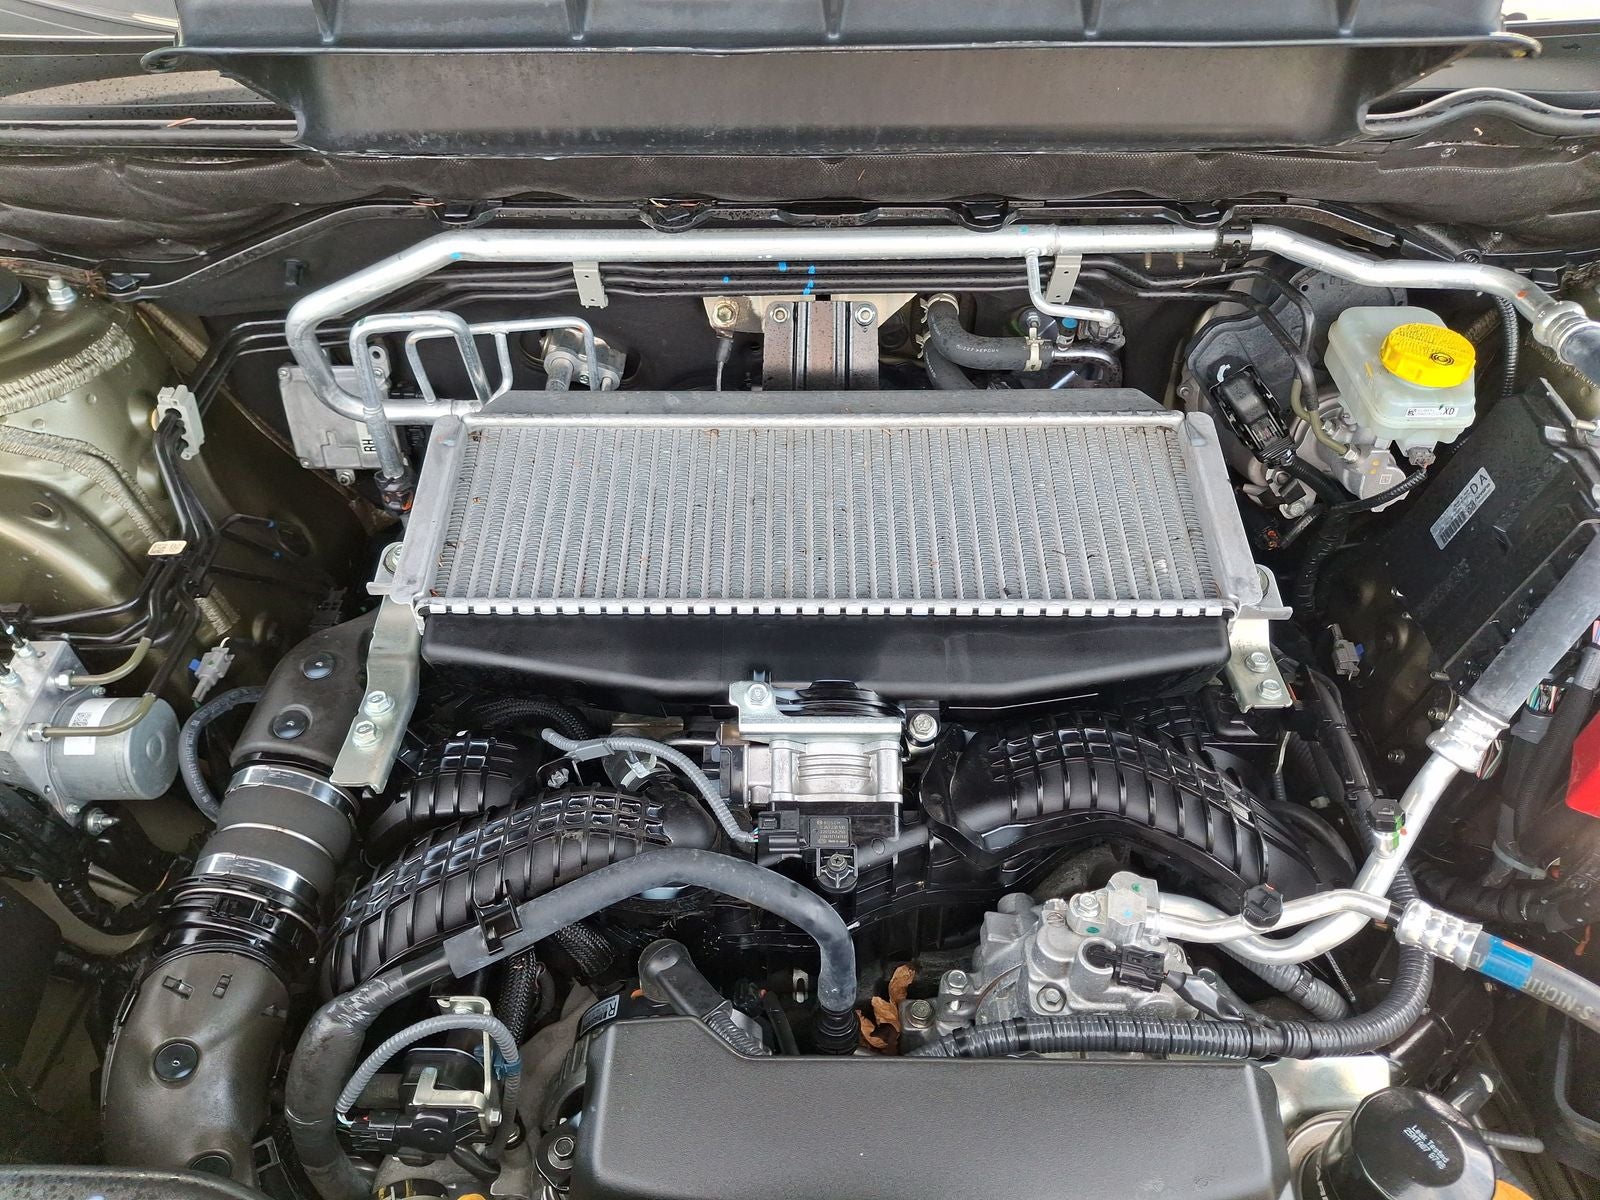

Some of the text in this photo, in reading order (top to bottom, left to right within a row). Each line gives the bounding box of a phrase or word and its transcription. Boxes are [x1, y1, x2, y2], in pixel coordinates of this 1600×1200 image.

[362, 439, 377, 452] RH
[1411, 1124, 1450, 1164] Leak Tested
